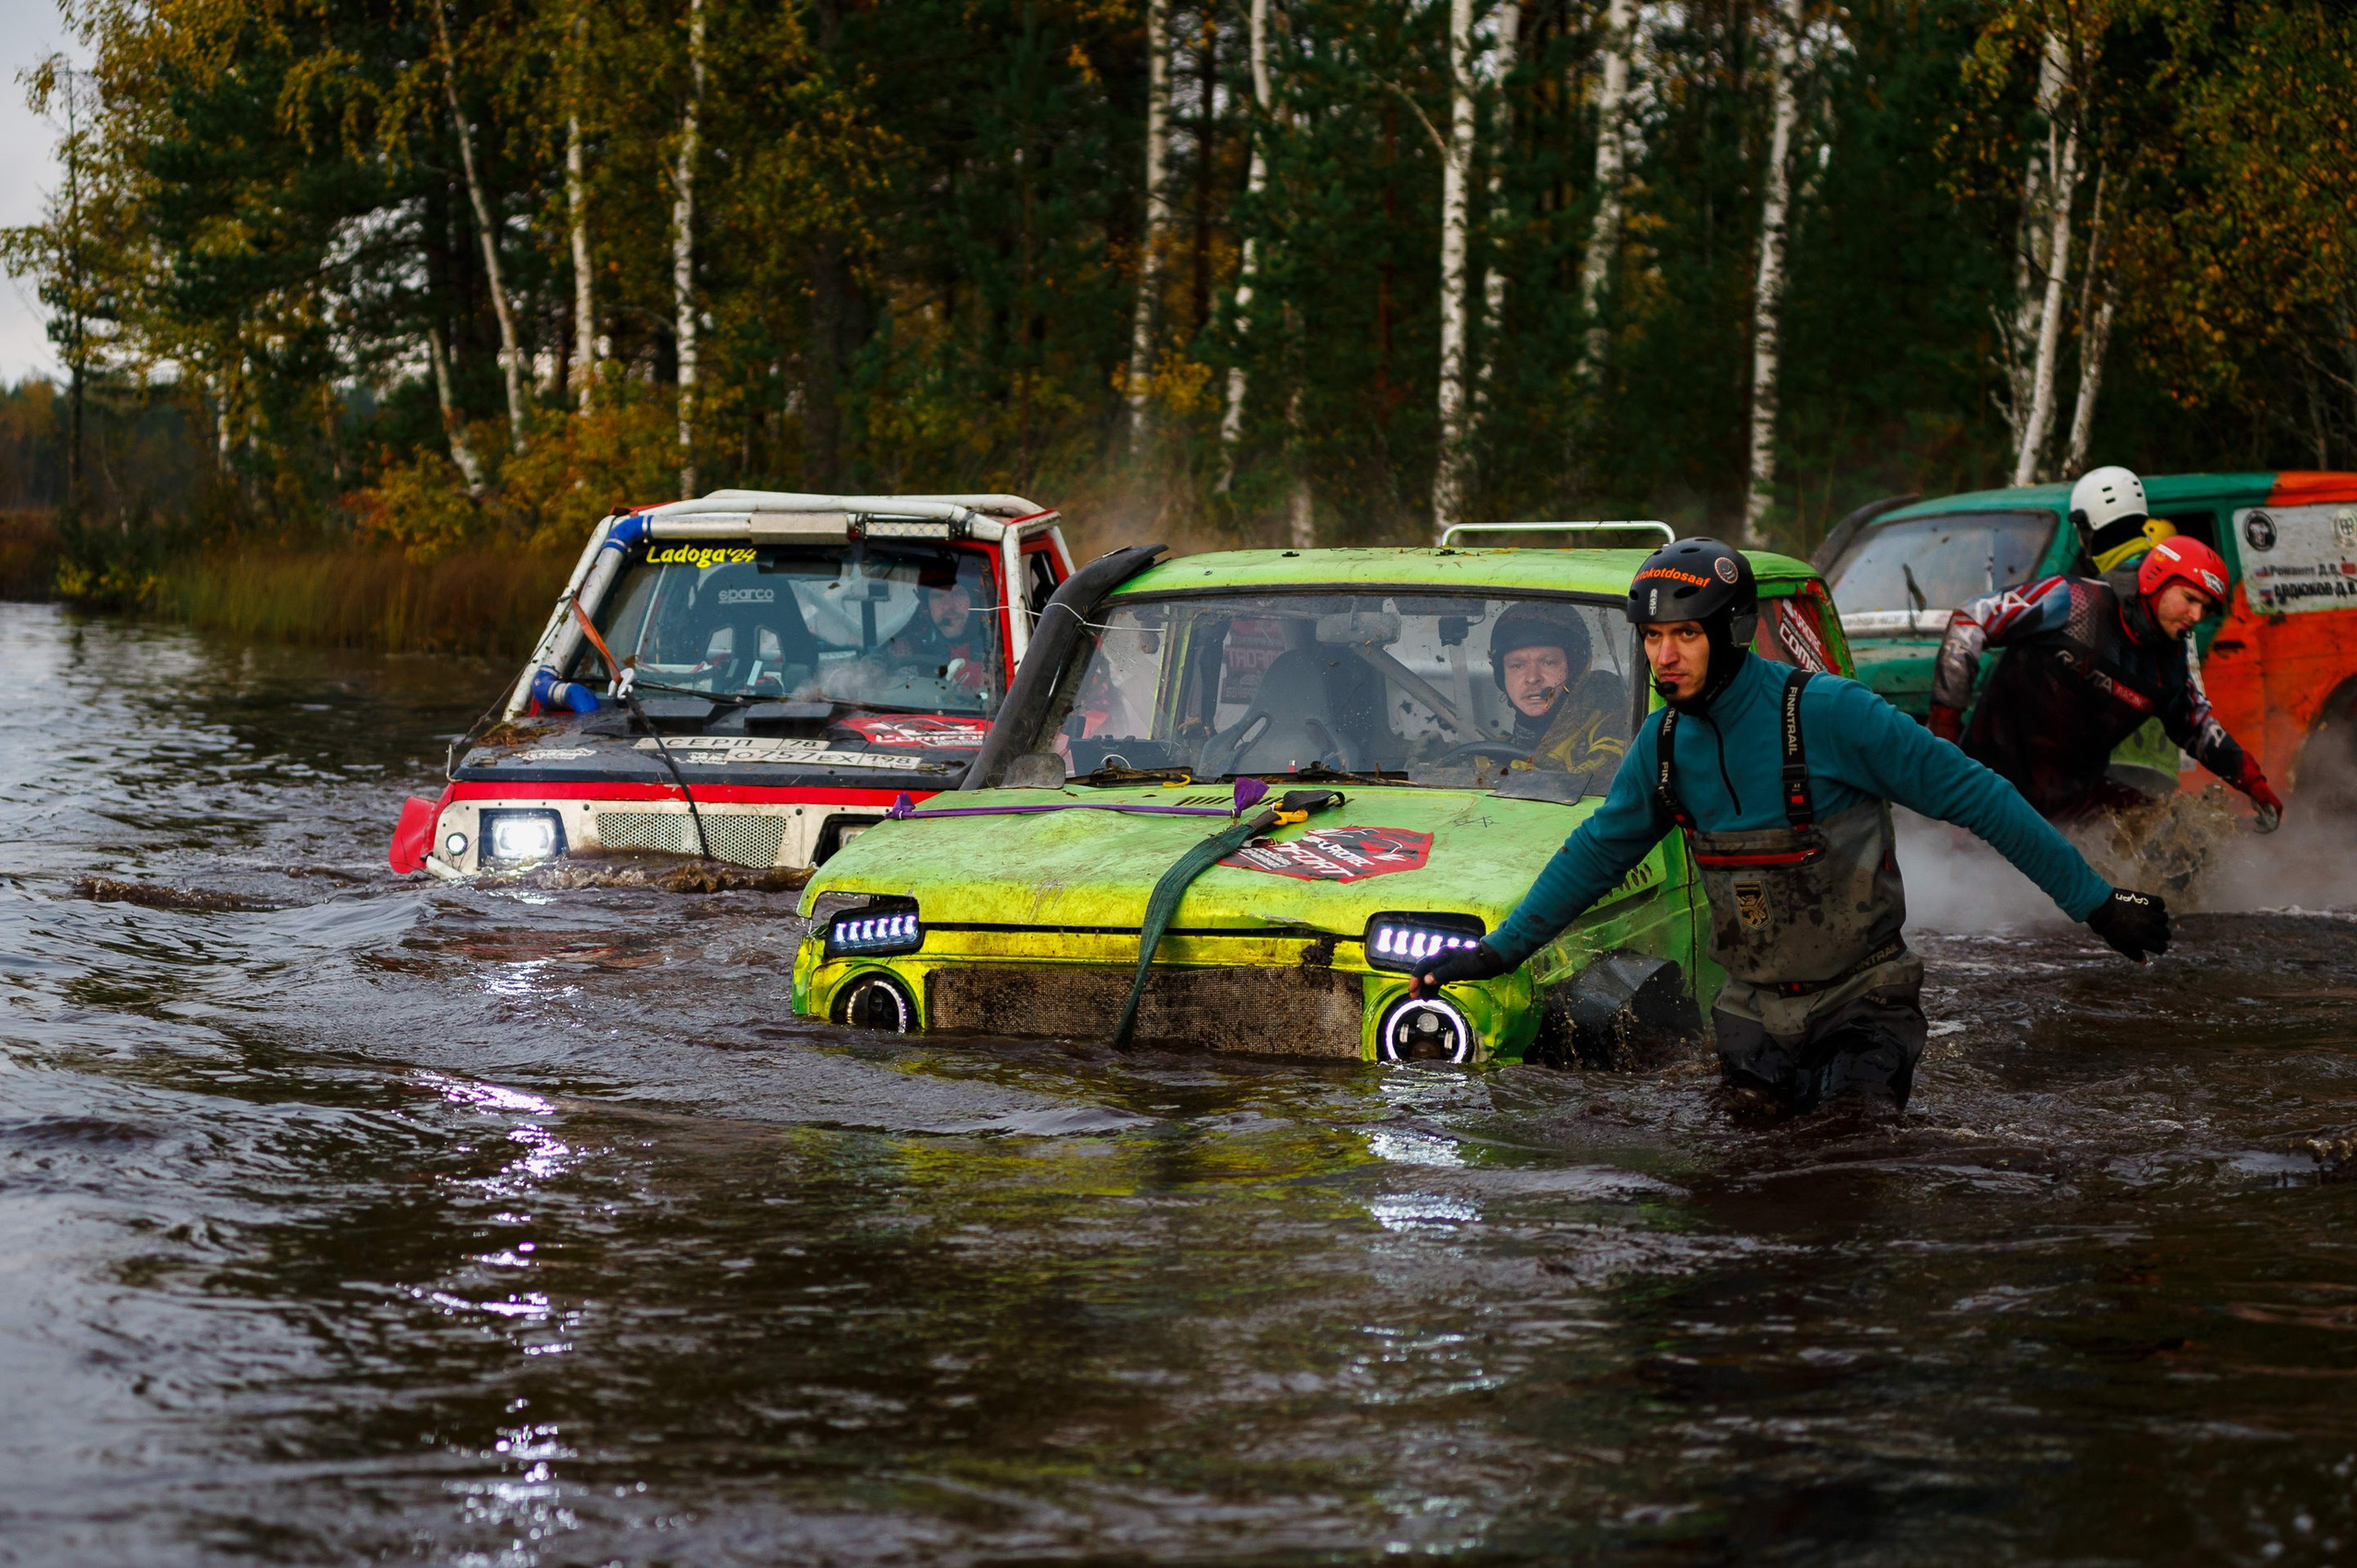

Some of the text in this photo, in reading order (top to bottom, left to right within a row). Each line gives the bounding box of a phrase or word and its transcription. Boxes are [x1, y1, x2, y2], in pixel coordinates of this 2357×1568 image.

[645, 543, 757, 569] Ladoga'24
[718, 588, 774, 604] sparco
[1786, 686, 1798, 756] FINNTRAIL
[791, 739, 818, 748] 78
[868, 753, 911, 764] 198
